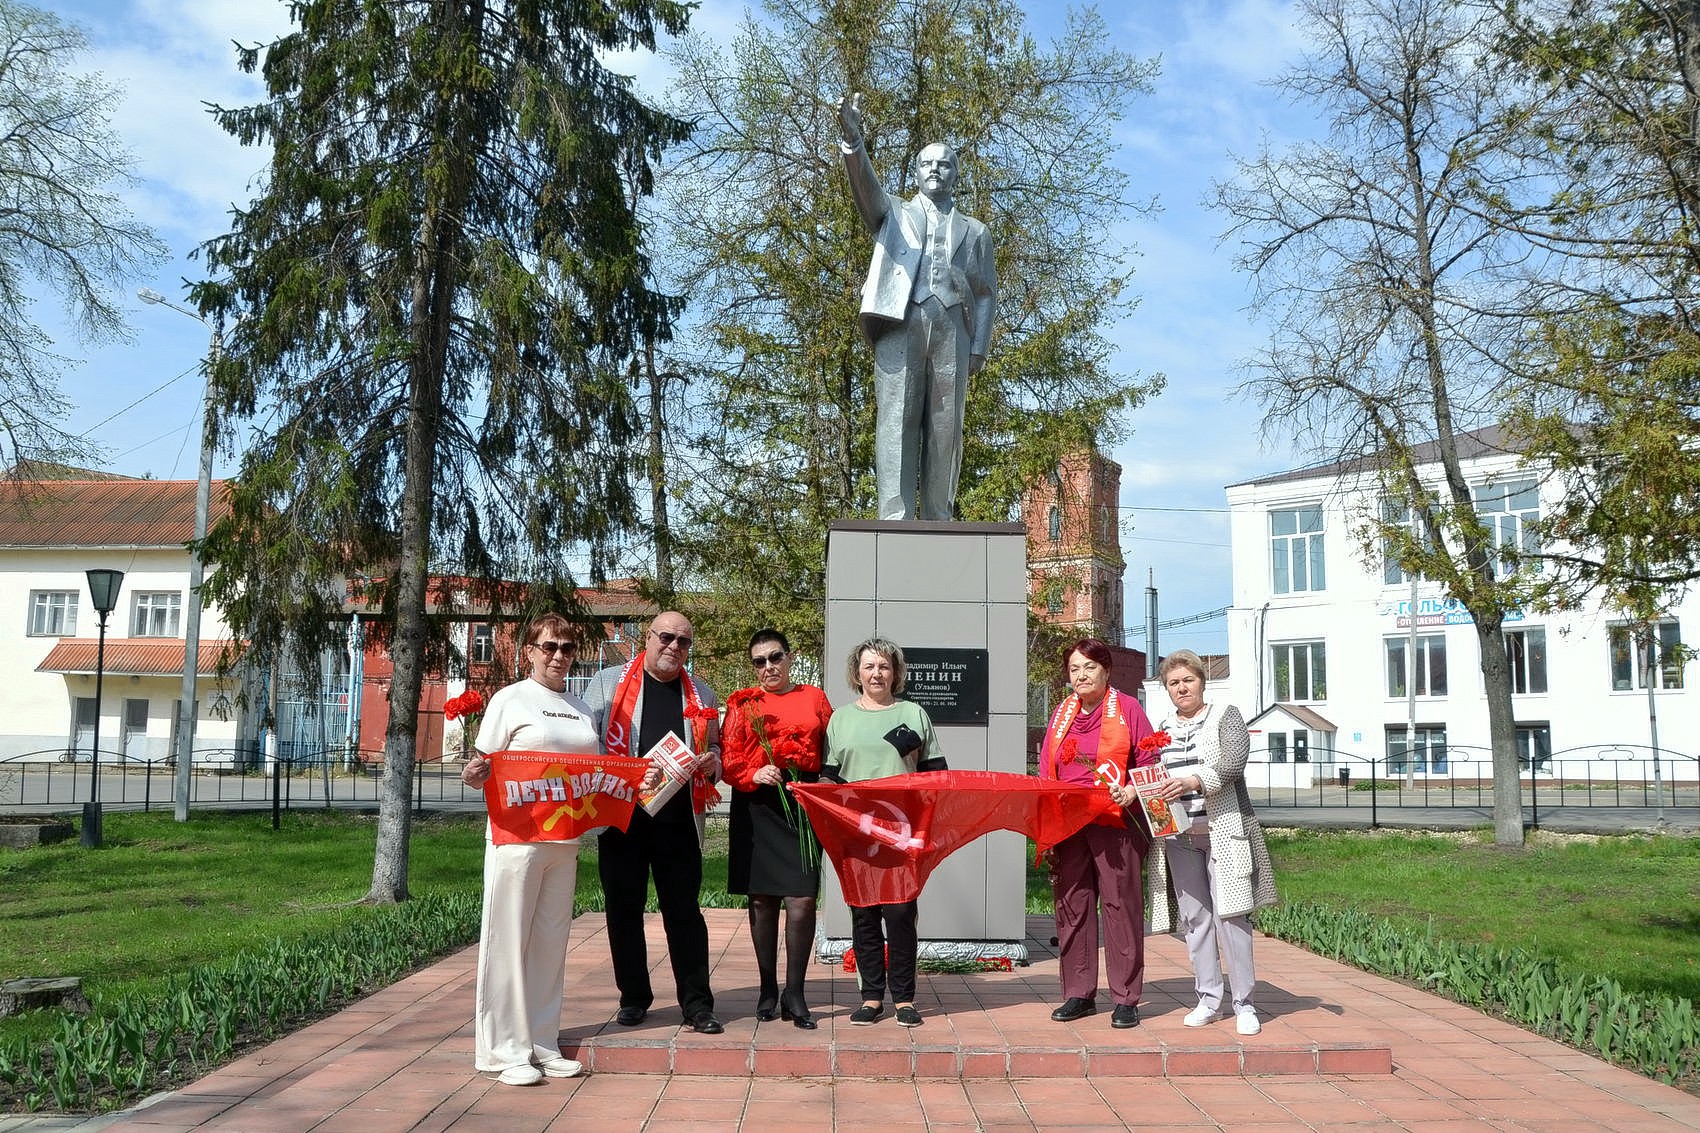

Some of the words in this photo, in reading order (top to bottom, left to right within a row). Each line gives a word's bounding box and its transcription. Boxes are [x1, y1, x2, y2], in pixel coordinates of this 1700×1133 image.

[904, 662, 939, 671] ладимир
[941, 661, 967, 670] Ильич
[904, 671, 962, 682] ЛЕНИН
[914, 683, 951, 691] (Ульянов)
[1055, 701, 1077, 739] ПАРТИЯ
[502, 754, 558, 764] ОБЩЕРОССИЙСКАЯ
[559, 758, 605, 767] ОБЩЕСТВЕННАЯ
[504, 776, 567, 807] ДЕТИ
[569, 769, 634, 803] ВОЙНЫ
